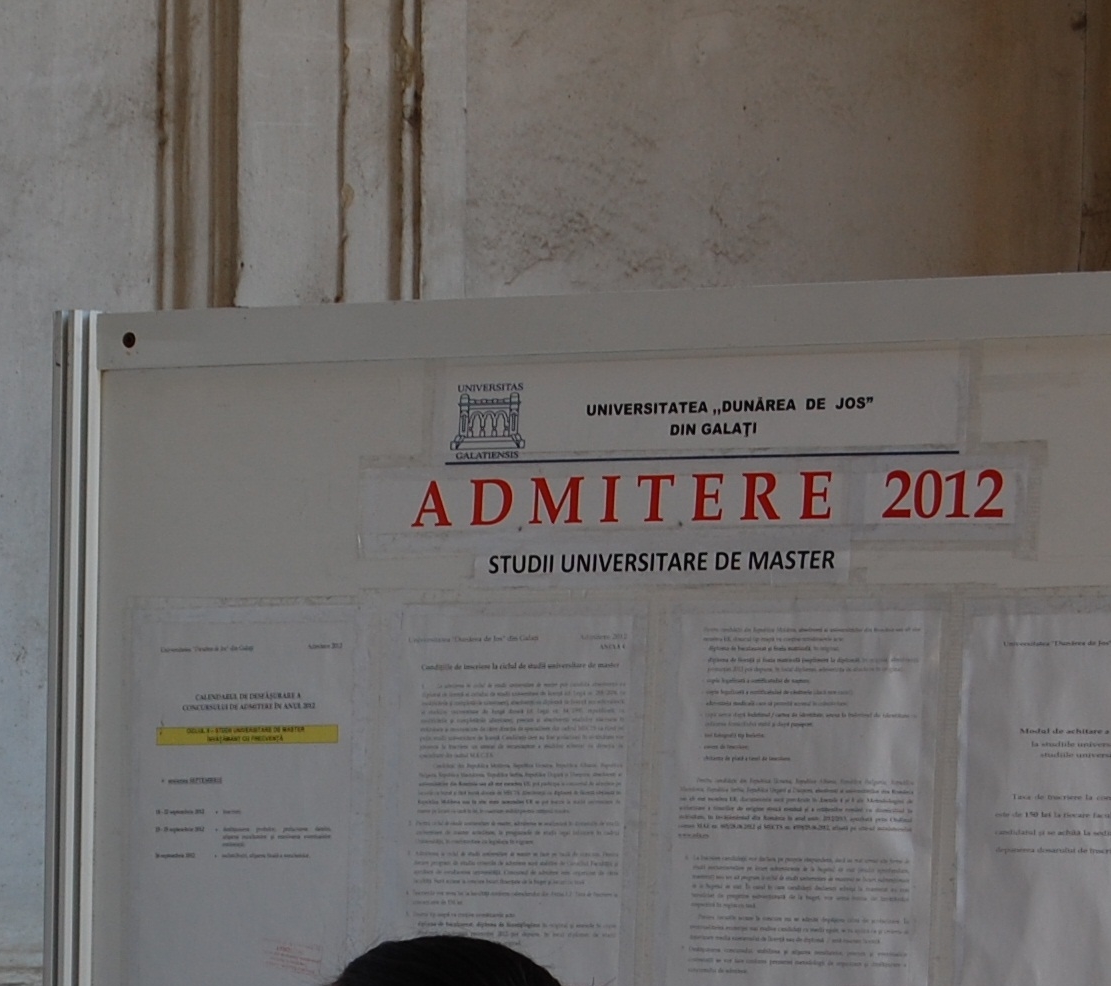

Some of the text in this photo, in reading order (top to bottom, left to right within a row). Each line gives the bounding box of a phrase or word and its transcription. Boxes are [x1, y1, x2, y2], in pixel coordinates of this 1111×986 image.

[457, 382, 524, 393] UNIVERSITAS
[586, 400, 708, 416] UNIVERSITATEA
[805, 397, 826, 410] DE
[670, 423, 696, 436] DIN
[455, 450, 519, 461] GALATIENSIS
[411, 468, 1005, 528] ADMITERE 2012
[489, 549, 834, 574] STUDII UNIVERSITARE DE MASTER
